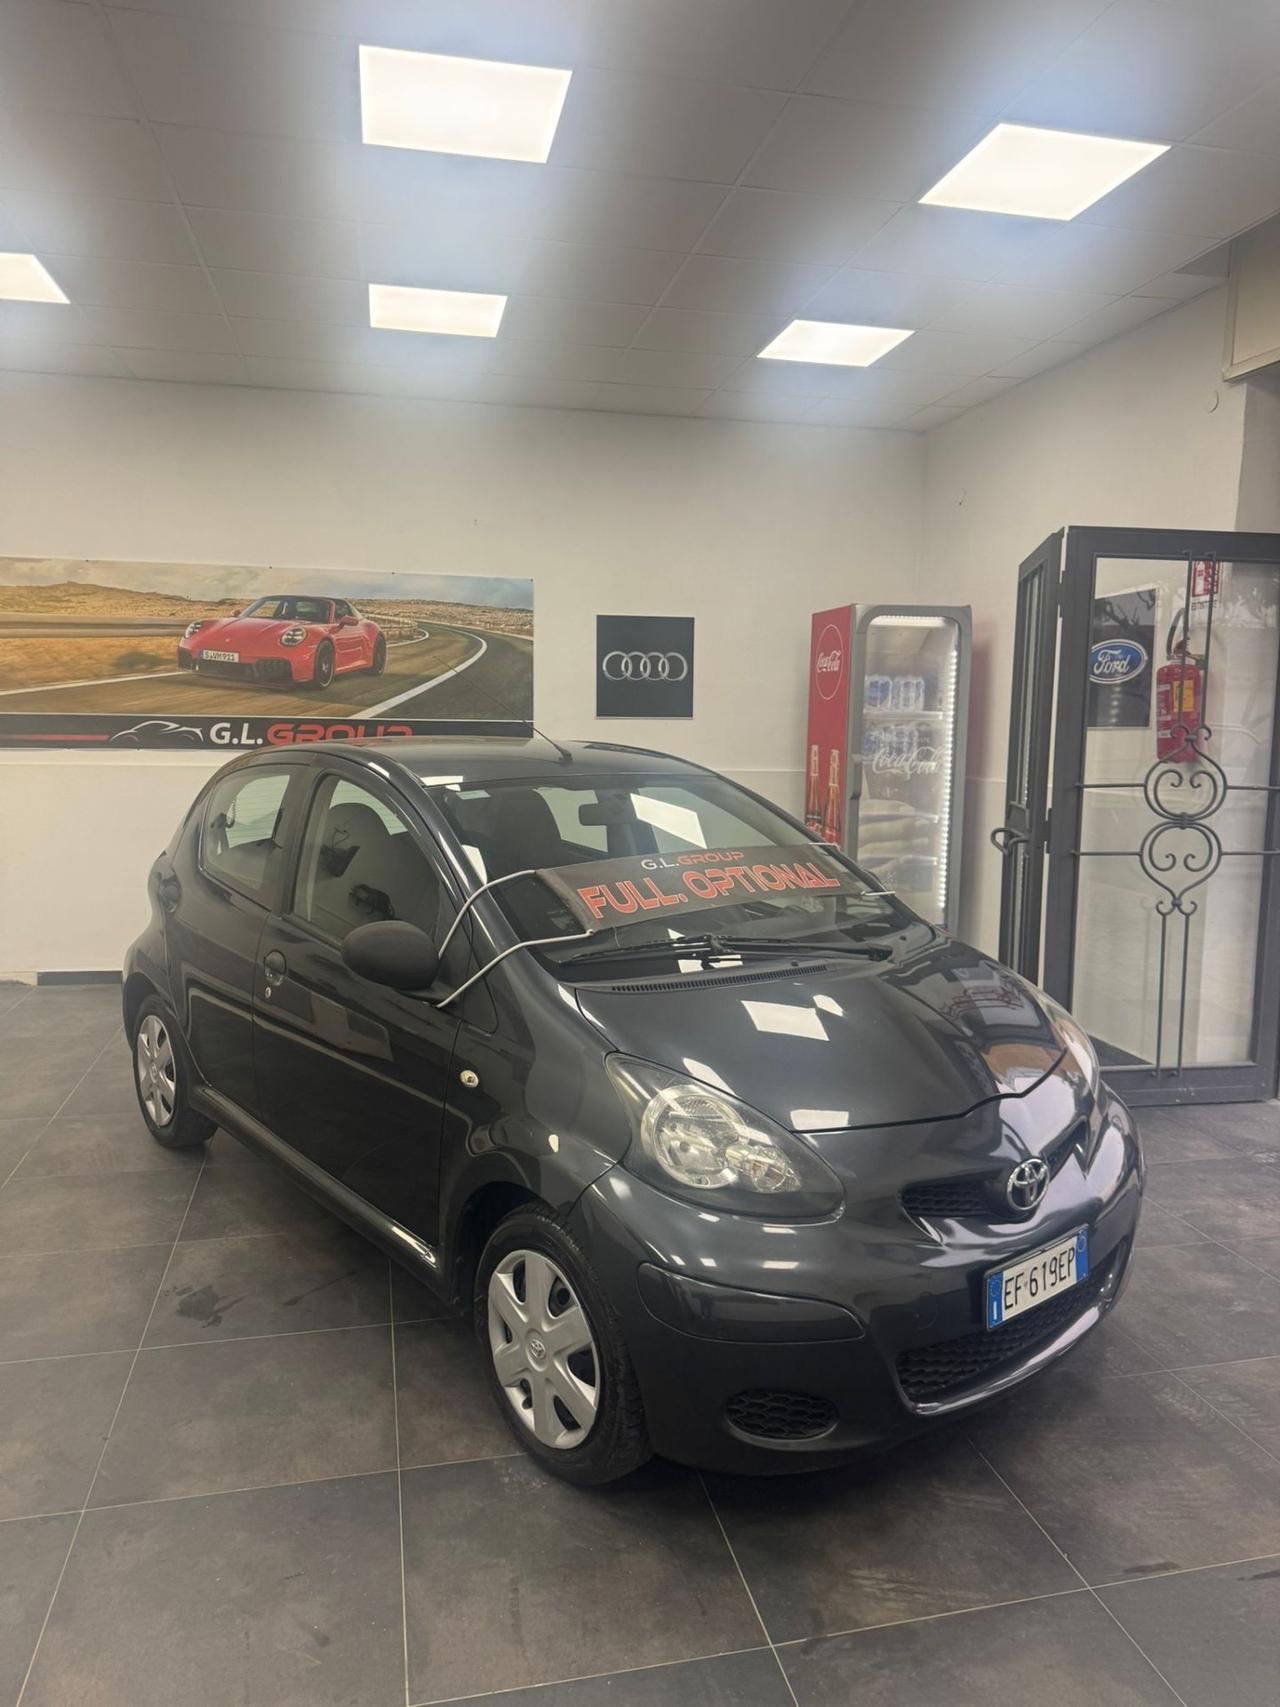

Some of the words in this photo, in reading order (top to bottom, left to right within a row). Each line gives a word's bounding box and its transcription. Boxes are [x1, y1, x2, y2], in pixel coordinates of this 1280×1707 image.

[1094, 649, 1131, 675] Ford
[577, 877, 689, 919] FULL.
[682, 862, 841, 898] OPTIONAL
